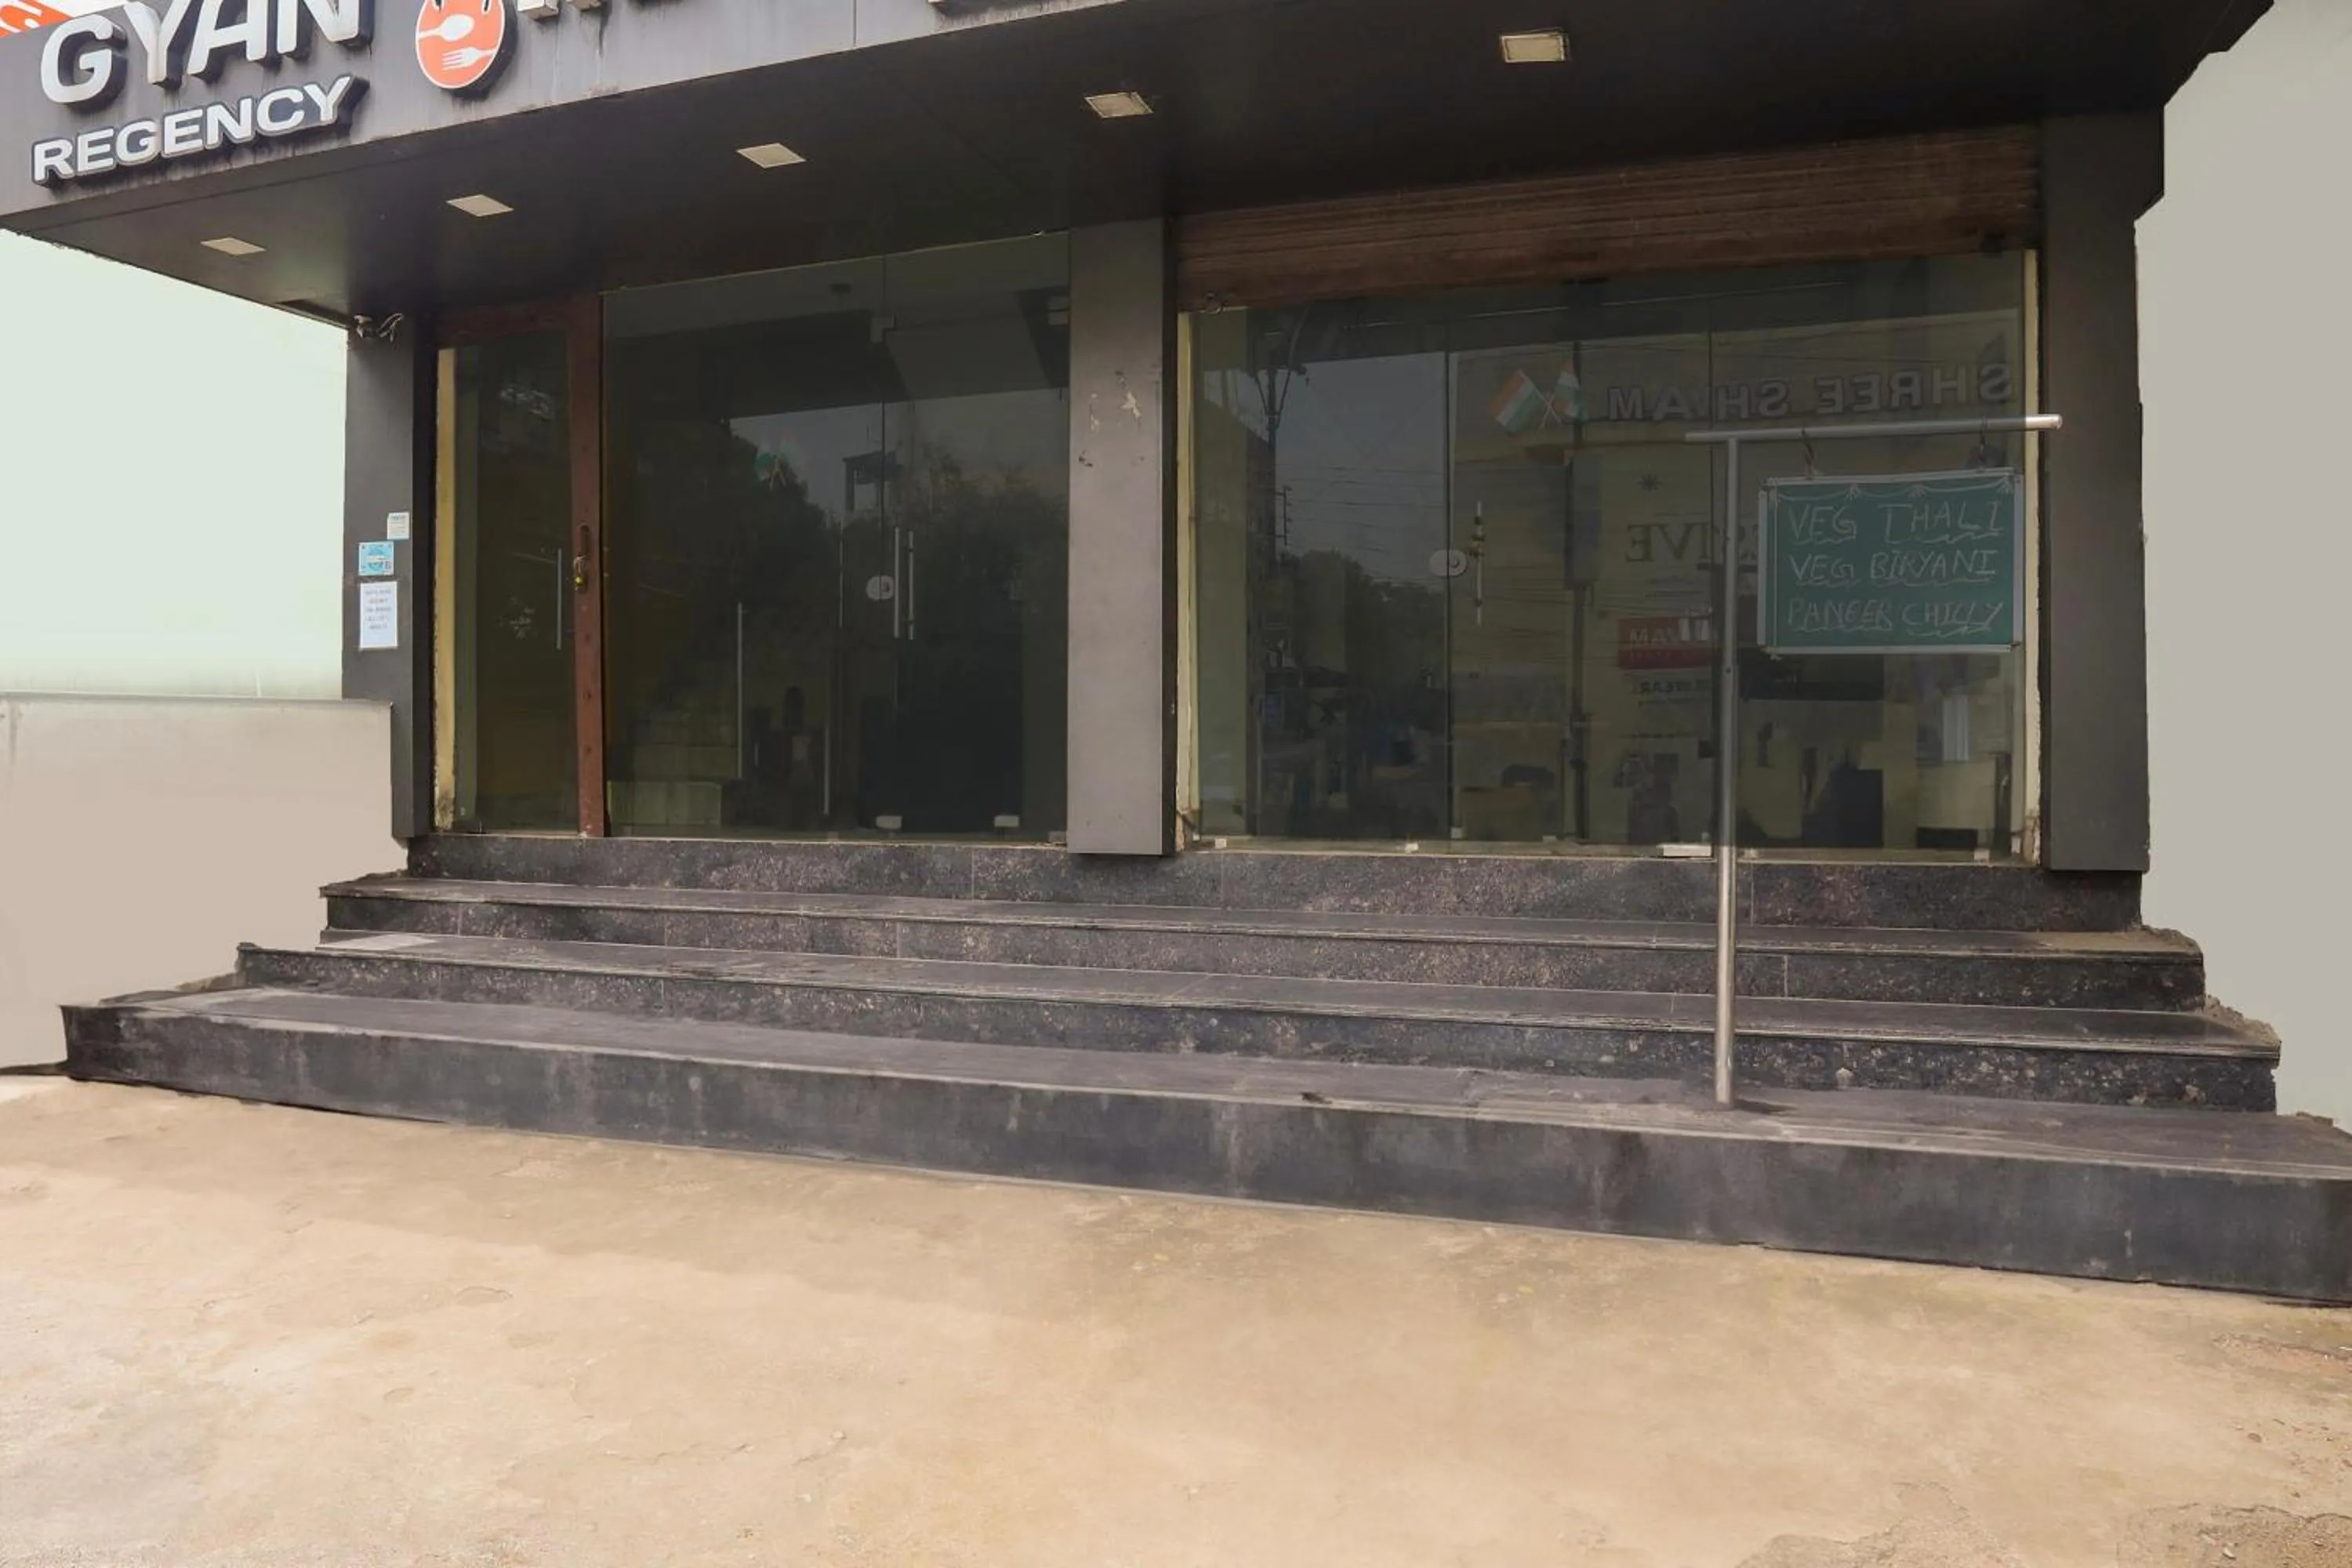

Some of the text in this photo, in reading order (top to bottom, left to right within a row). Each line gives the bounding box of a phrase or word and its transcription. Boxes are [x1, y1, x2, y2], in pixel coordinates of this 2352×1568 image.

[32, 74, 353, 184] REGENCY
[1788, 499, 2004, 543] VEG THALI
[1788, 549, 1998, 581] VEG BIRYANI
[1901, 601, 2005, 627] CHILLY
